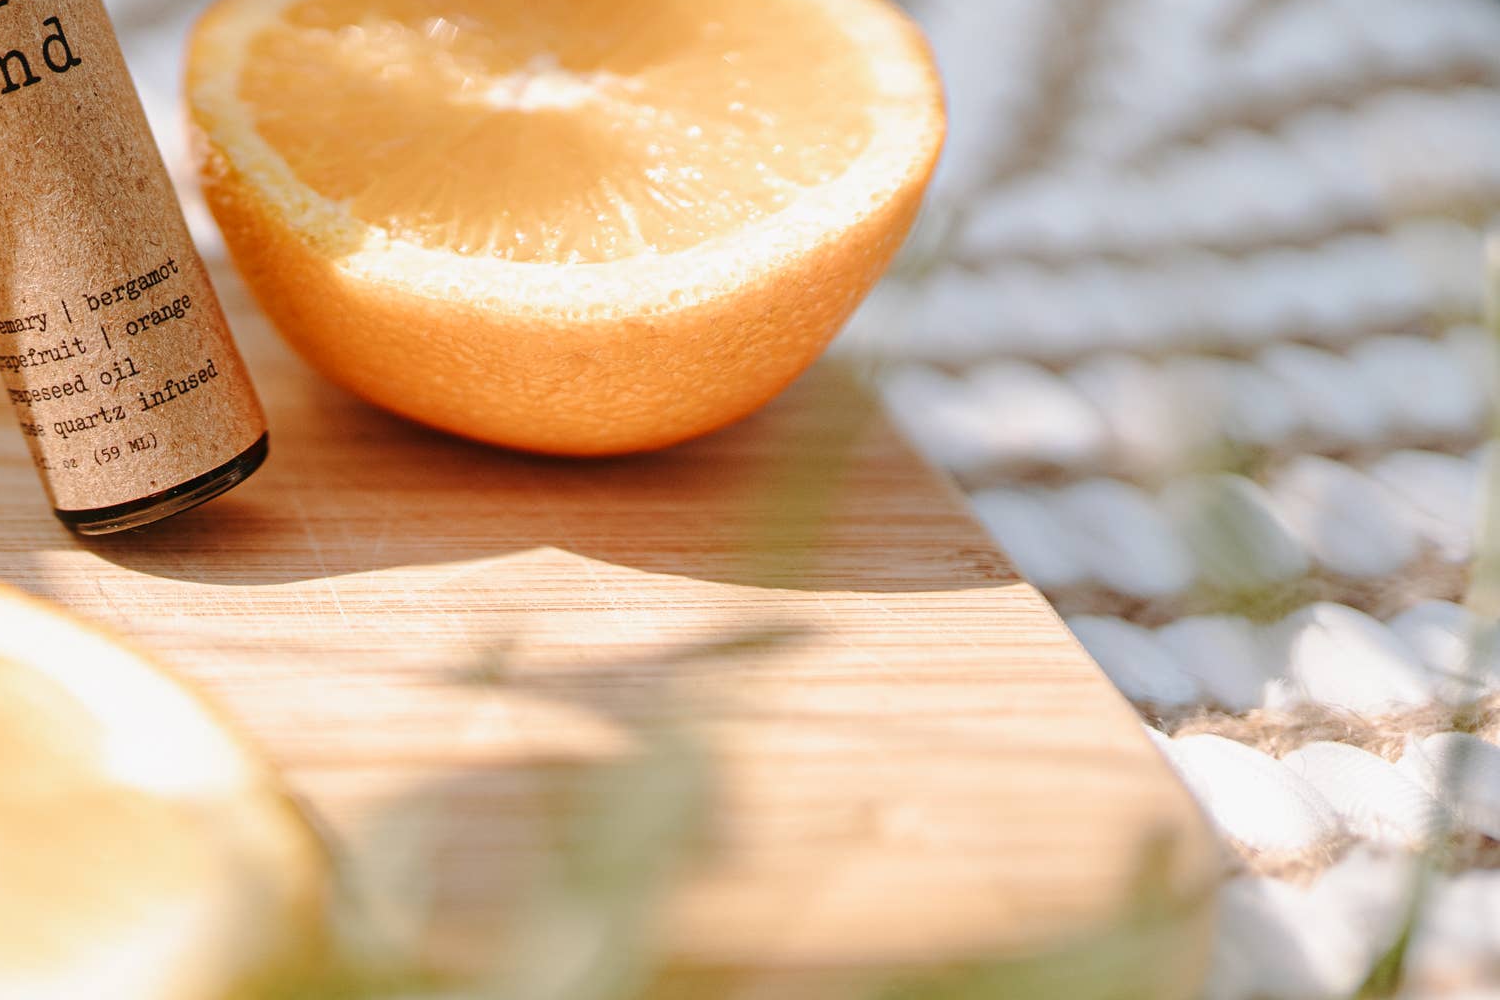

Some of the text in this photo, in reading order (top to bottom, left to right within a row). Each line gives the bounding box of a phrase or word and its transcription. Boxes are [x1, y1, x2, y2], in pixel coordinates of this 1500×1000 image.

[83, 256, 179, 313] bergamot
[126, 293, 192, 336] orange
[100, 357, 141, 385] oil
[54, 405, 127, 439] quartz
[139, 359, 218, 412] infused
[93, 446, 121, 466] (59
[128, 432, 158, 453] ML)
